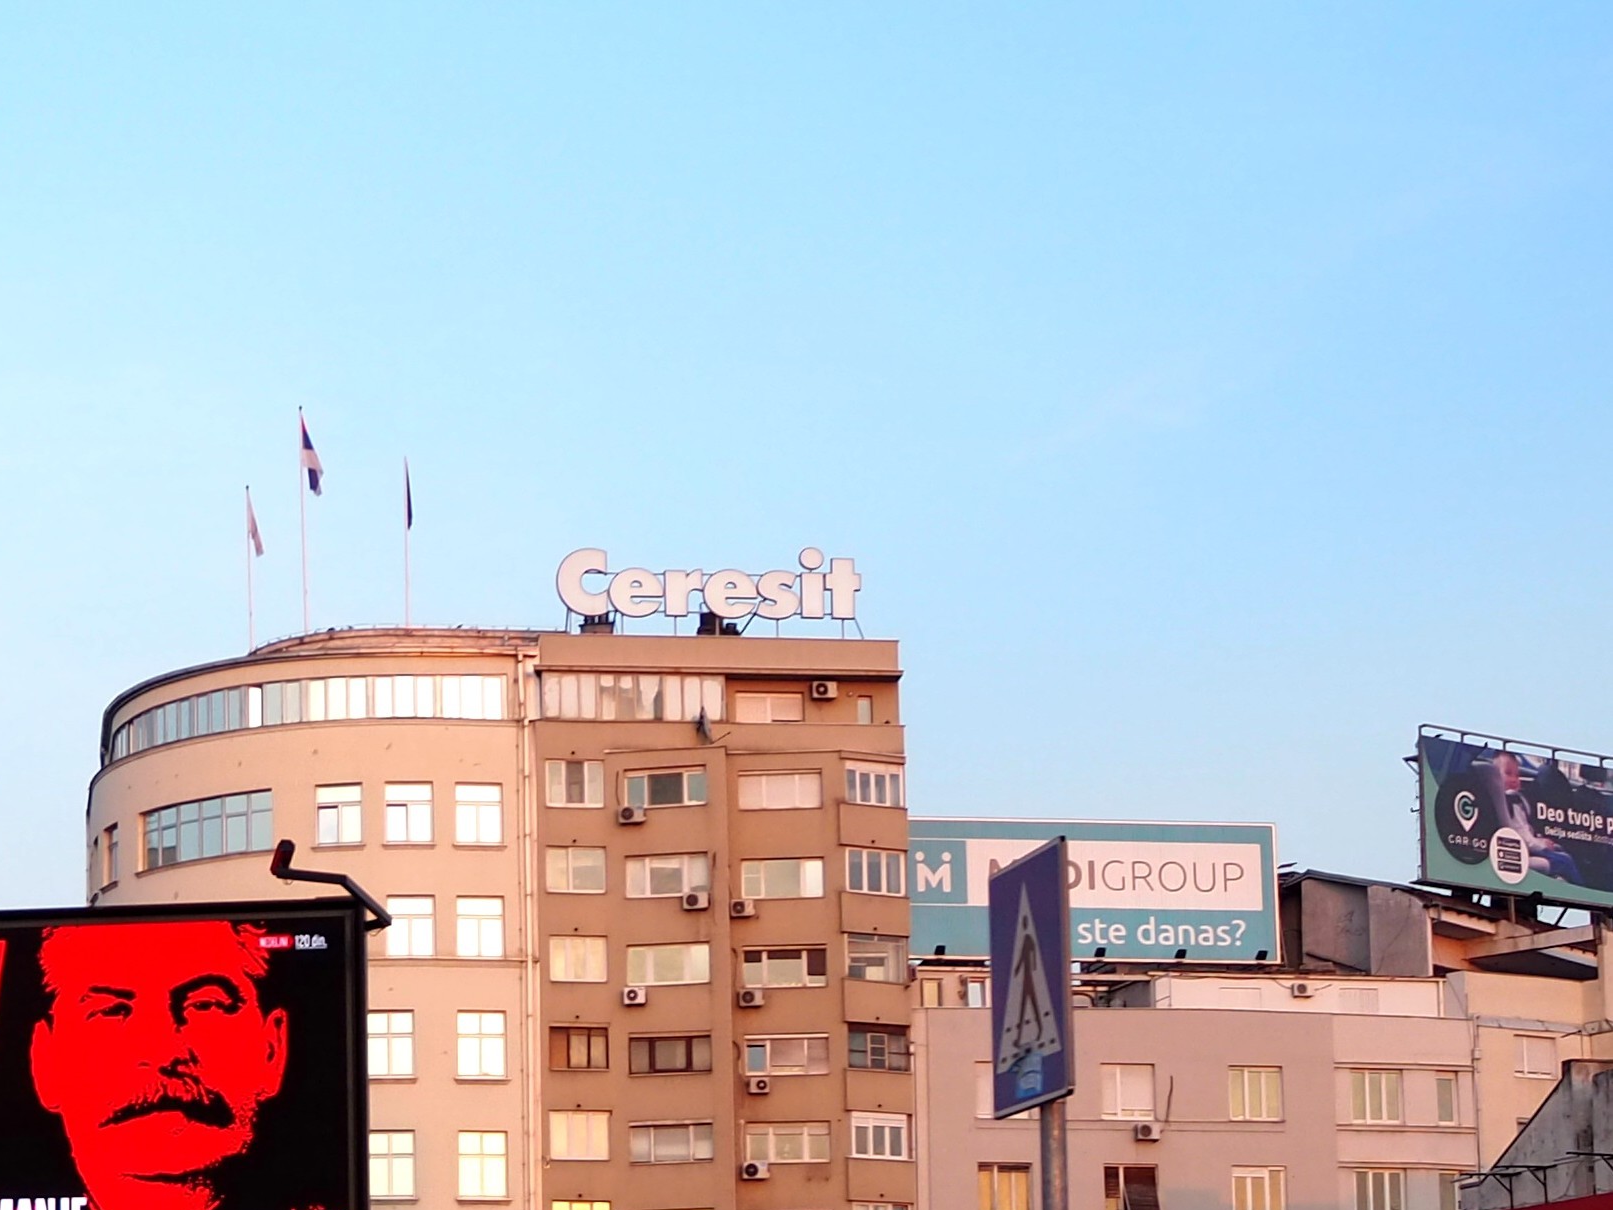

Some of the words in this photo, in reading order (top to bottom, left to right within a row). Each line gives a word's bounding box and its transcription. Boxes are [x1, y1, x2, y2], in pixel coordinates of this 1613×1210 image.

[556, 547, 862, 620] Ceresit
[1536, 802, 1564, 822] Deo
[1567, 808, 1603, 831] tvoje
[1077, 921, 1127, 945] ste
[1137, 916, 1247, 947] danas?
